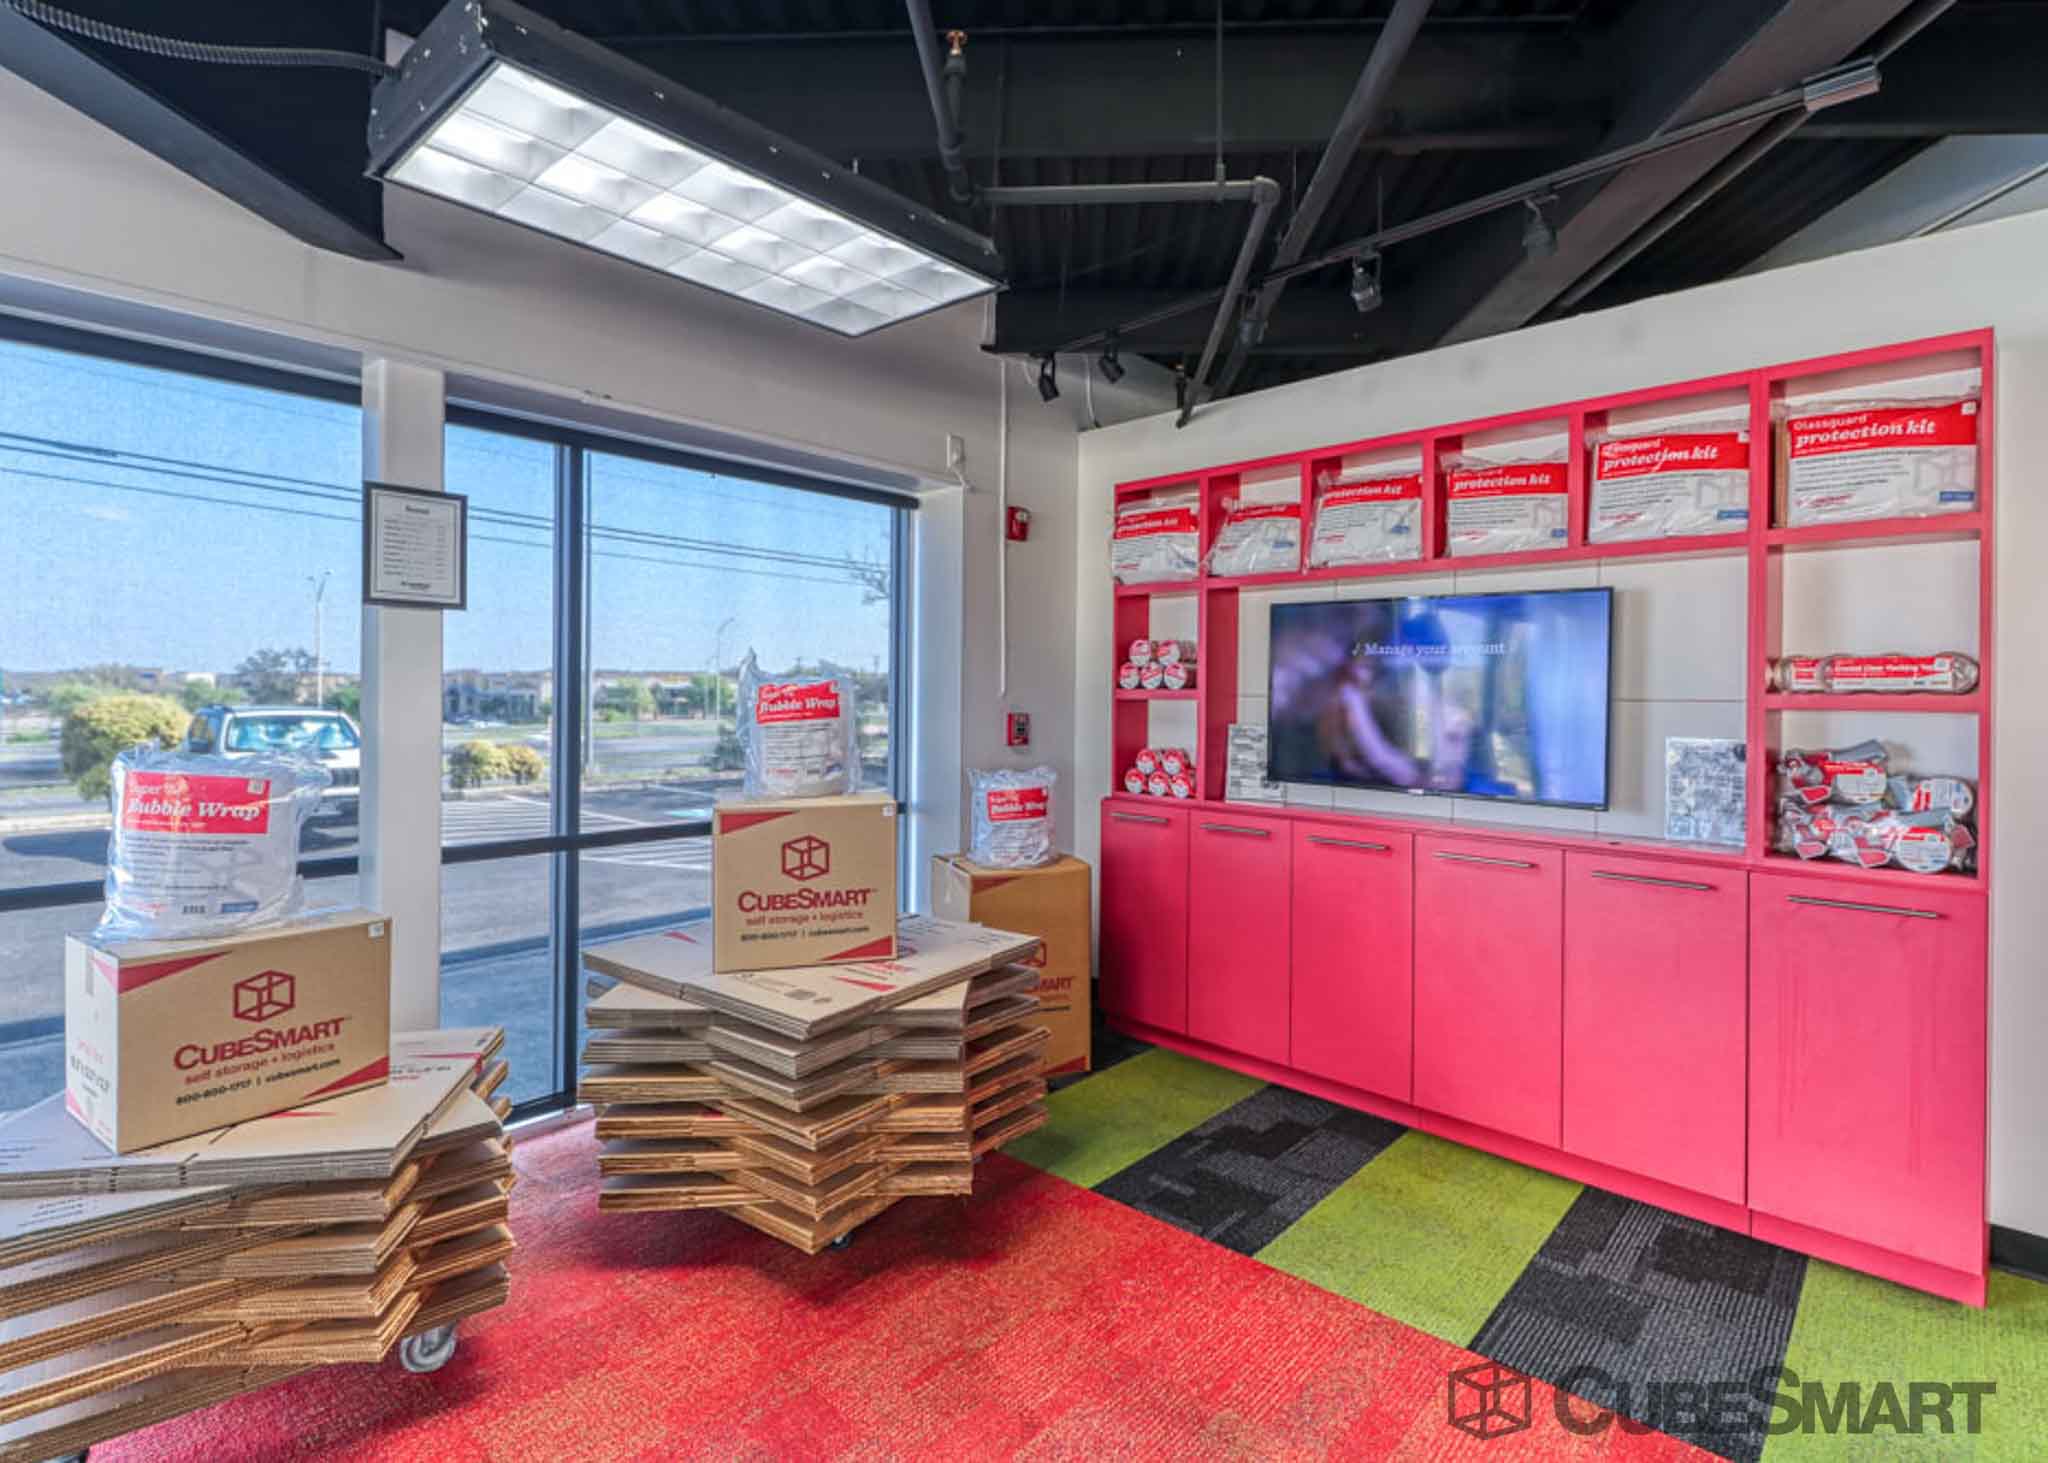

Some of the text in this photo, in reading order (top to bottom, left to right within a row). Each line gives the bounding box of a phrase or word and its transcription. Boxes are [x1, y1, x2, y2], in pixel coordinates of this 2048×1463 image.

[1792, 415, 1867, 431] Glassguard
[1794, 418, 1936, 448] protection kit
[1603, 445, 1718, 471] protection kit
[1453, 473, 1551, 492] protection kit
[1364, 642, 1415, 657] Manage
[1416, 645, 1448, 657] your
[197, 802, 261, 821] Wrap
[215, 1058, 270, 1078] storage
[280, 1043, 335, 1064] logistics
